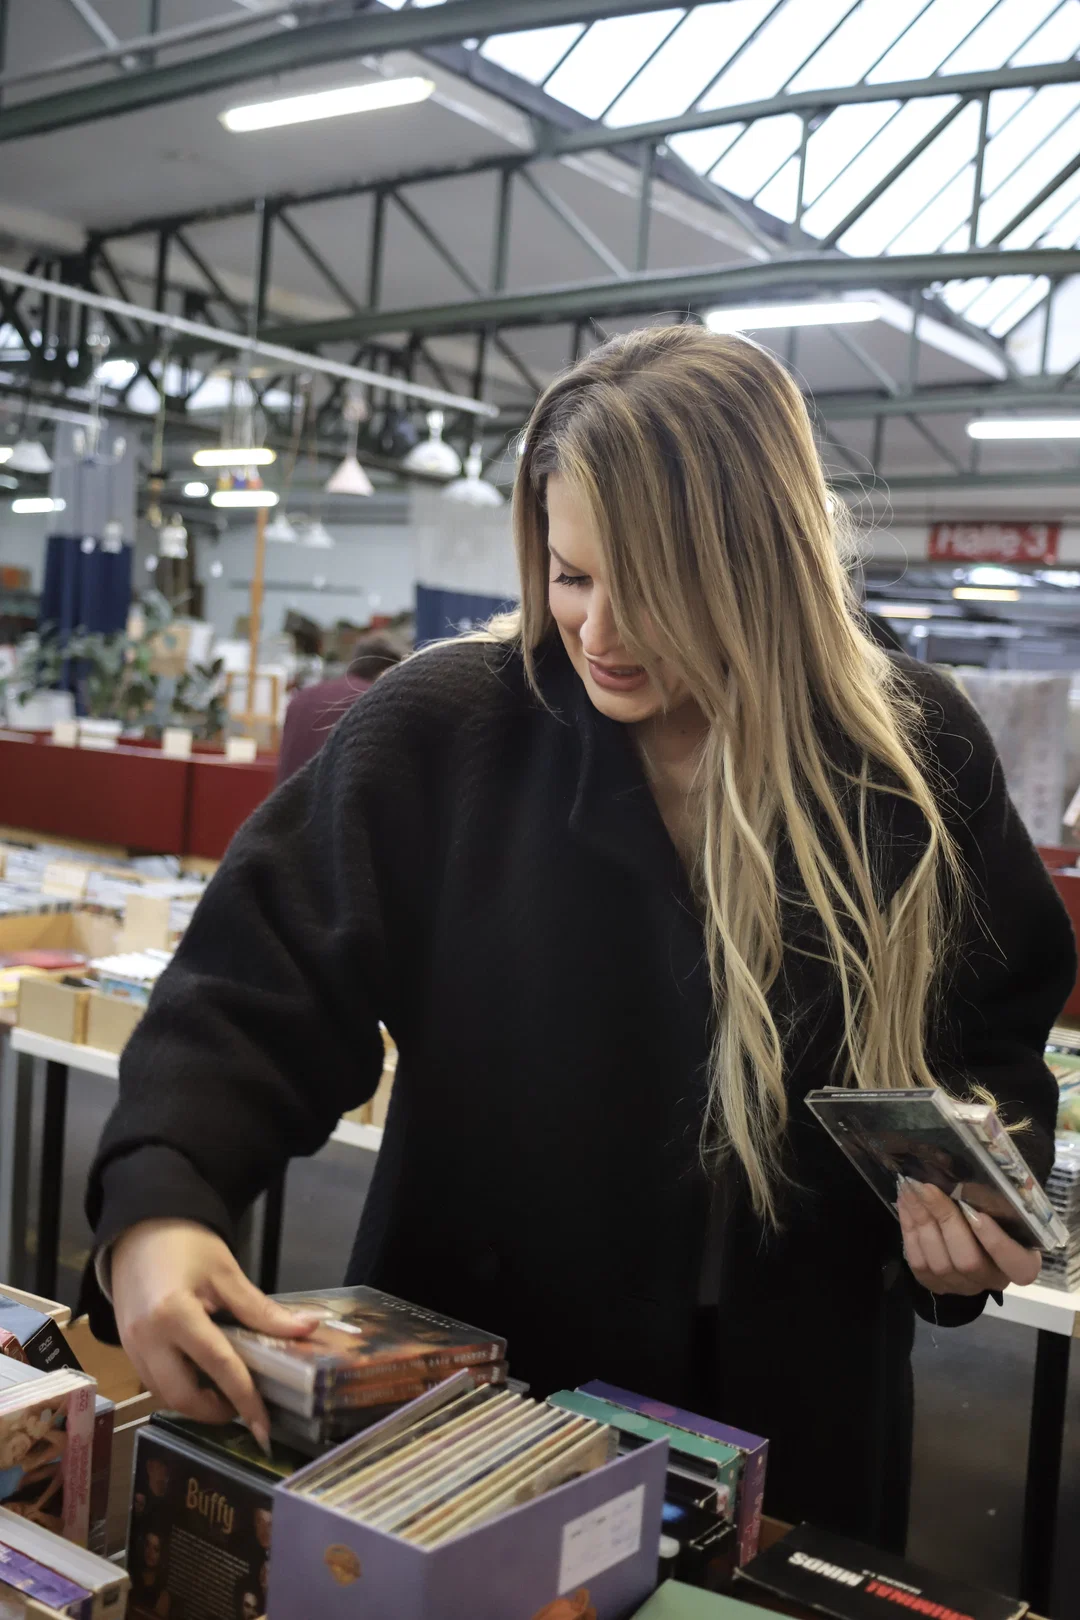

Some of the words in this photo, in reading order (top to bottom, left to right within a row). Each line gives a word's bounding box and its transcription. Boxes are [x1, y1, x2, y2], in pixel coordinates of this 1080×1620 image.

[936, 524, 1021, 557] Halle
[1025, 523, 1048, 558] 3
[38, 1335, 53, 1353] DVD
[45, 1347, 60, 1365] HBO
[186, 1477, 235, 1534] Buffy
[788, 1551, 865, 1587] MINDS
